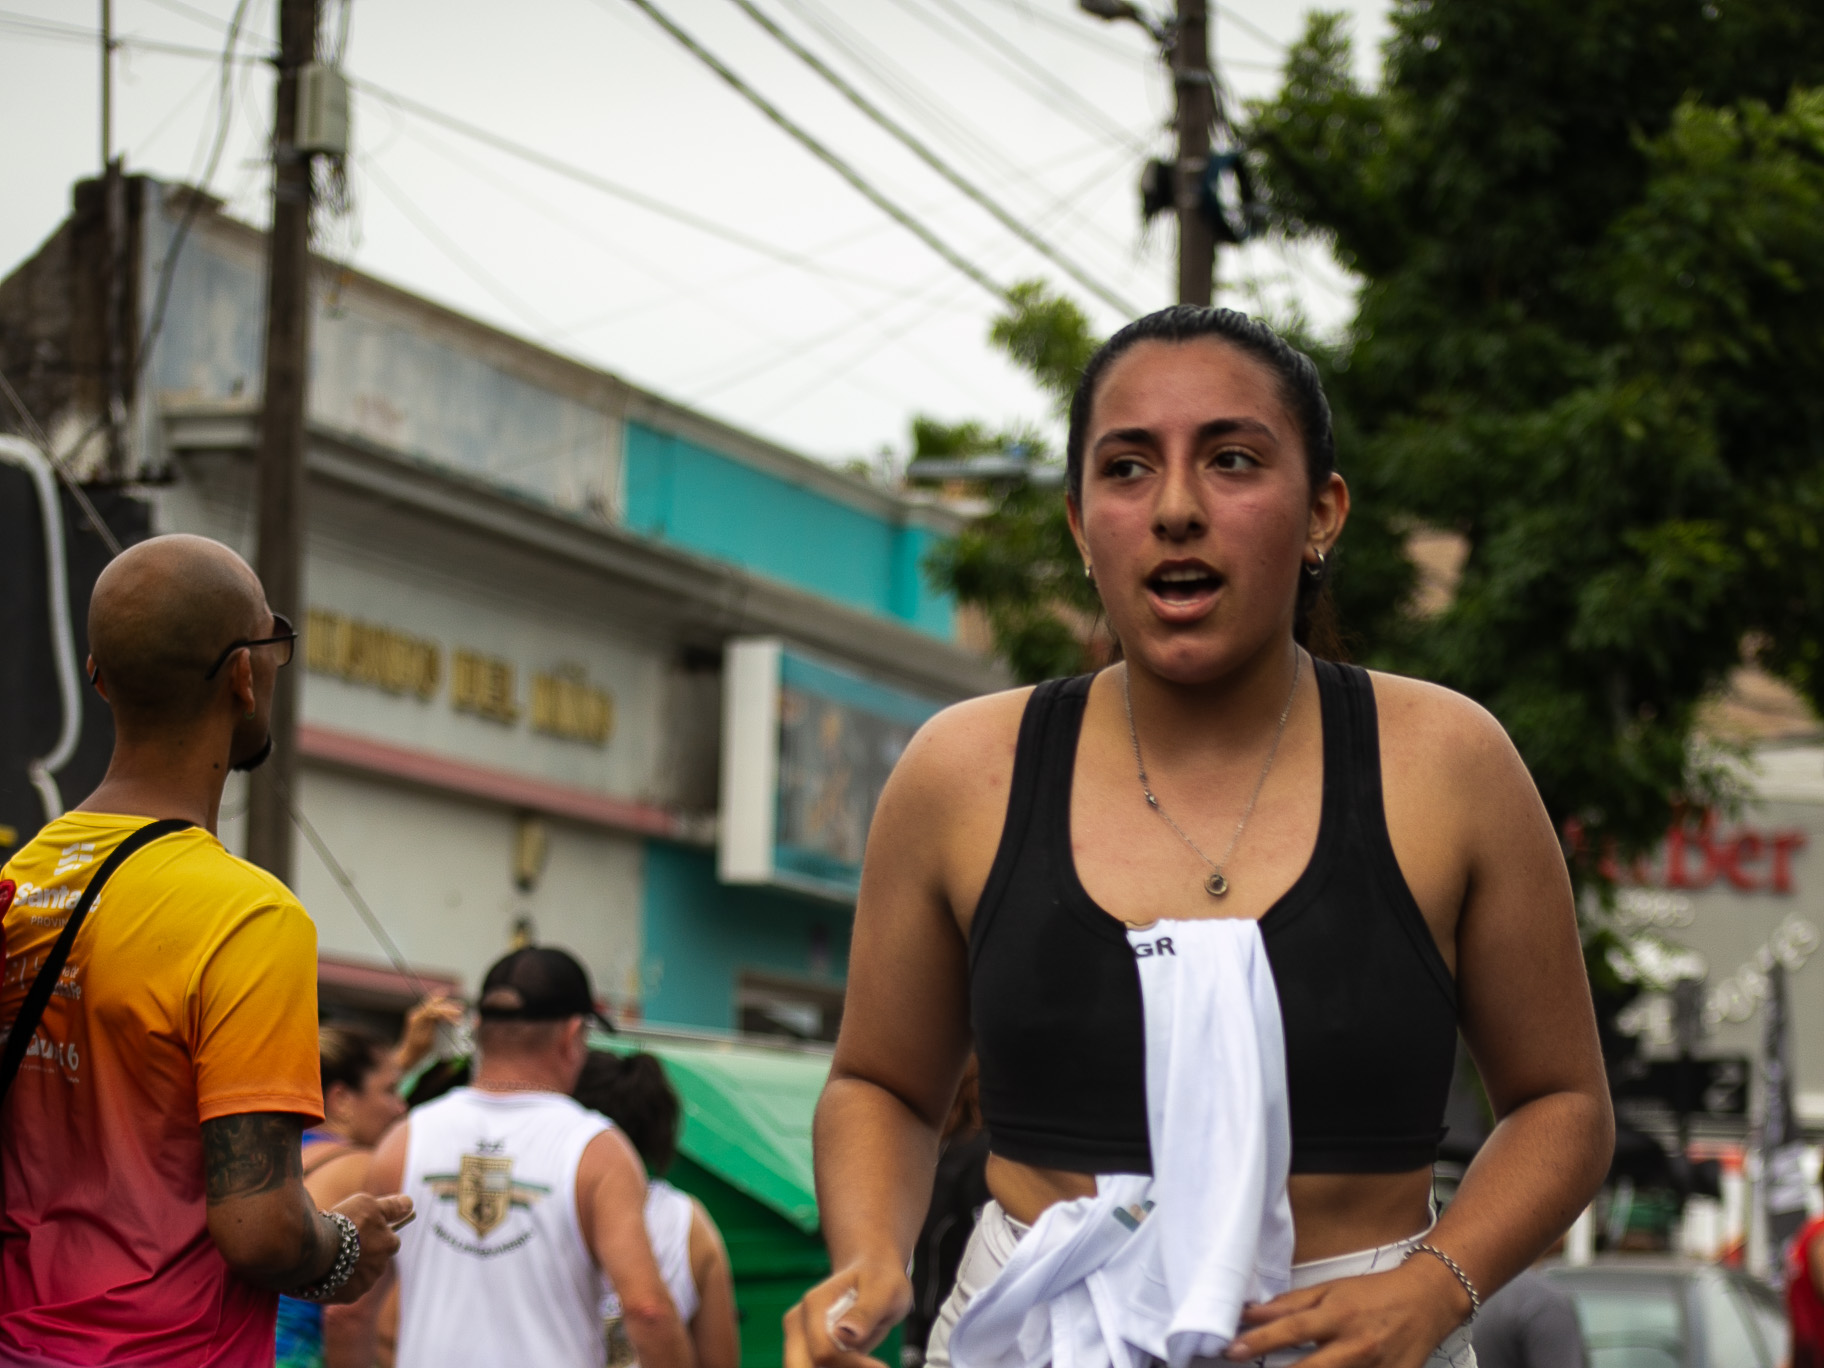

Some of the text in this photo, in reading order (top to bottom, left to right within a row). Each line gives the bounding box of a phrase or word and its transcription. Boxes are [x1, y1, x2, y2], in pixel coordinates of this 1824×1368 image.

[453, 647, 520, 728] DEL
[13, 882, 82, 909] Santa
[67, 1043, 79, 1071] 6
